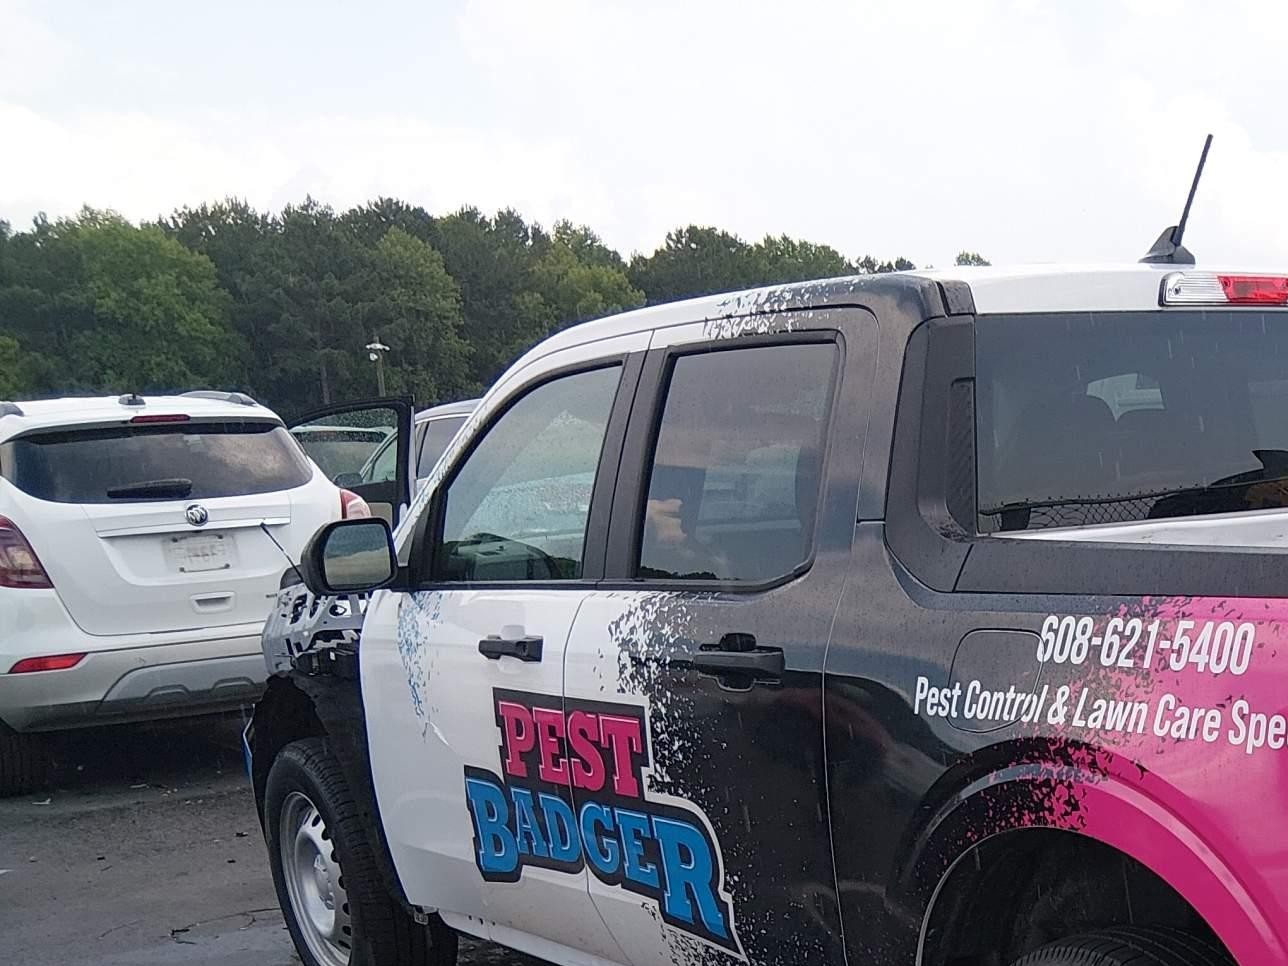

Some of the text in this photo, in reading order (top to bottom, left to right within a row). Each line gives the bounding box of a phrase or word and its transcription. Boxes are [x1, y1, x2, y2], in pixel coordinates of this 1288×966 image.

[1036, 615, 1255, 675] 608-621-5400
[499, 700, 642, 798] PEST
[914, 676, 961, 718] Pest
[963, 680, 1048, 723] Control
[1047, 685, 1070, 724] &
[1072, 687, 1148, 734] Lawn
[1153, 694, 1221, 743] Care
[465, 777, 728, 940] BADGER
